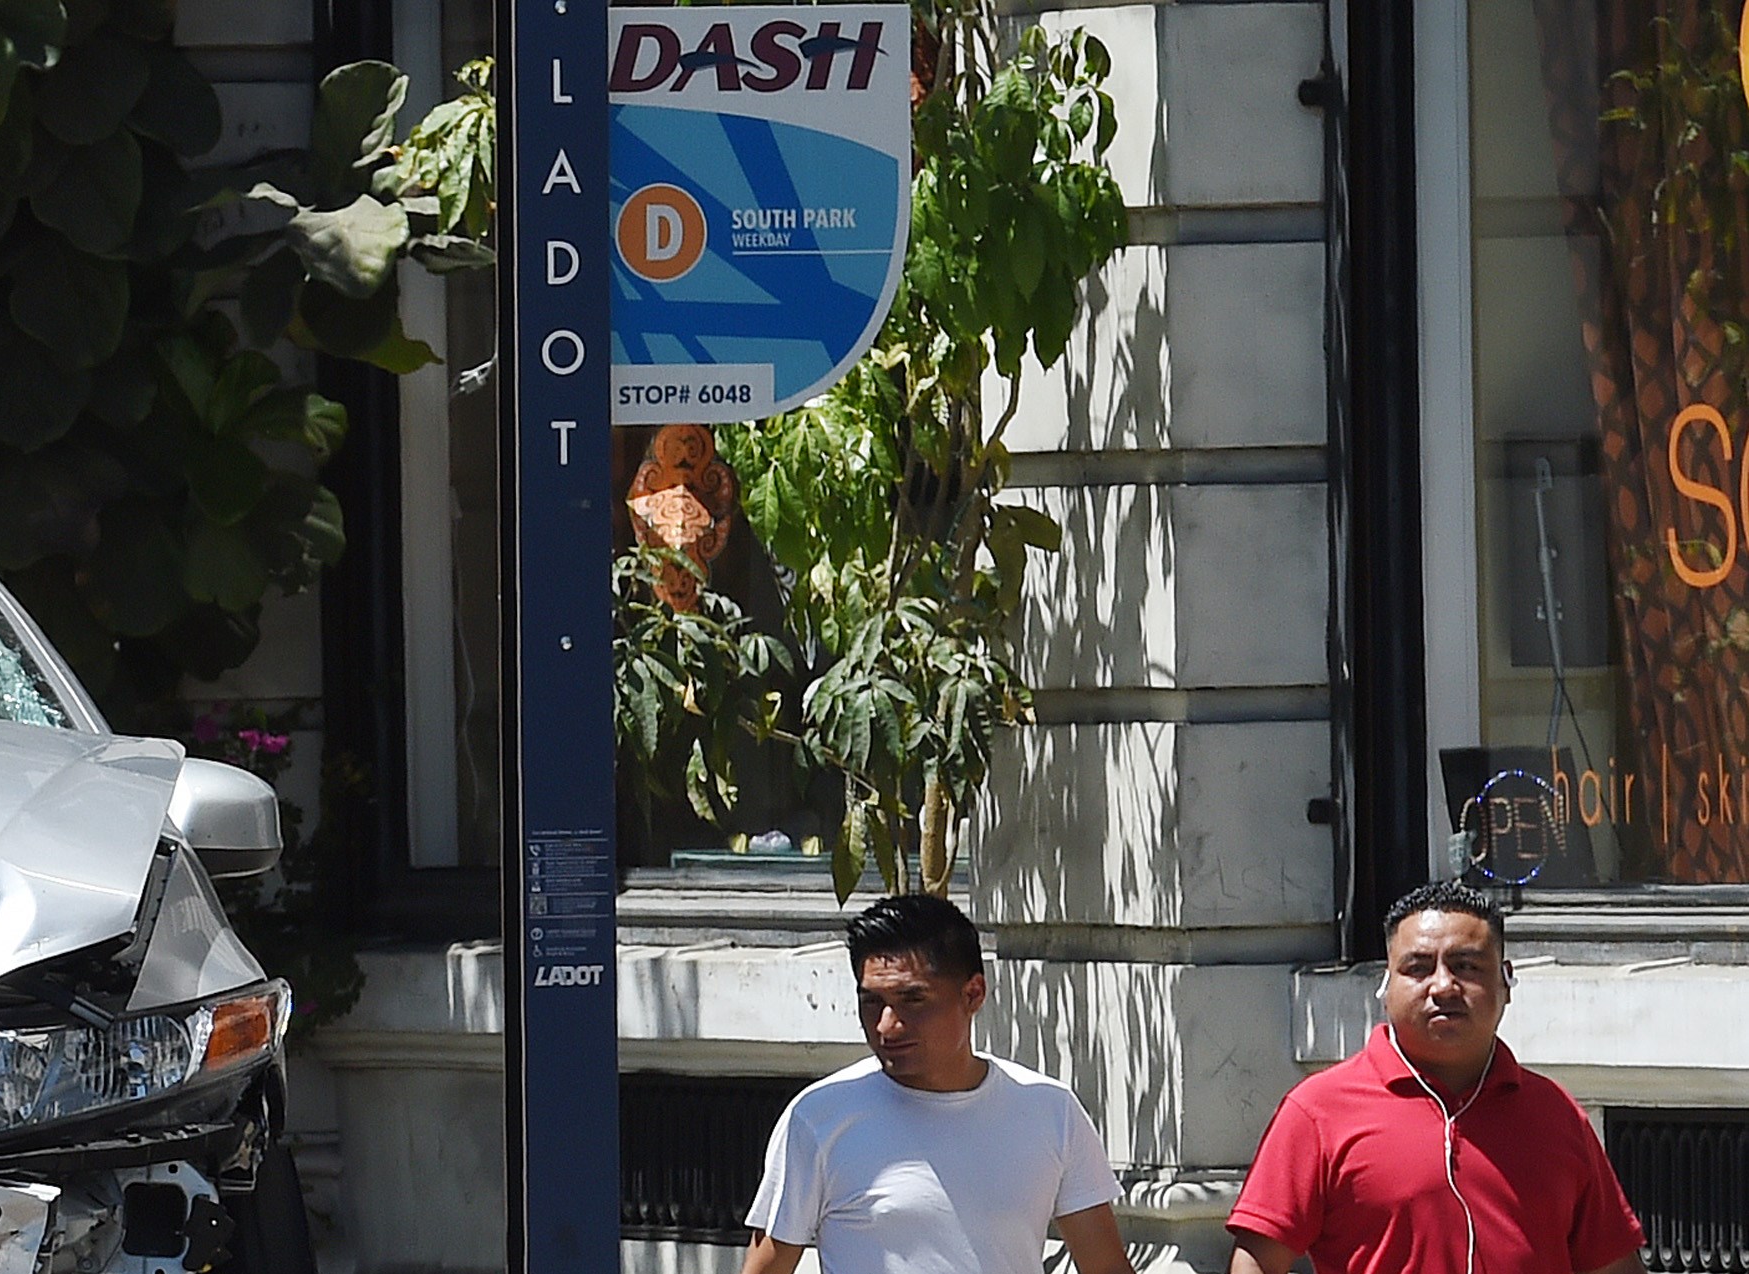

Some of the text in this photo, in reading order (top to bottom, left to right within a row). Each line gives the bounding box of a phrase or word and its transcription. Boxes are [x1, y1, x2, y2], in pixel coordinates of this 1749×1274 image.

[609, 21, 887, 93] DASH
[644, 203, 683, 262] D
[731, 207, 857, 231] SOUTH PARK
[731, 232, 792, 249] WEEKDAY
[541, 58, 585, 466] LADOT
[618, 384, 752, 405] STOP# 6048
[1551, 743, 1635, 828] hair
[534, 964, 605, 987] LADOT
